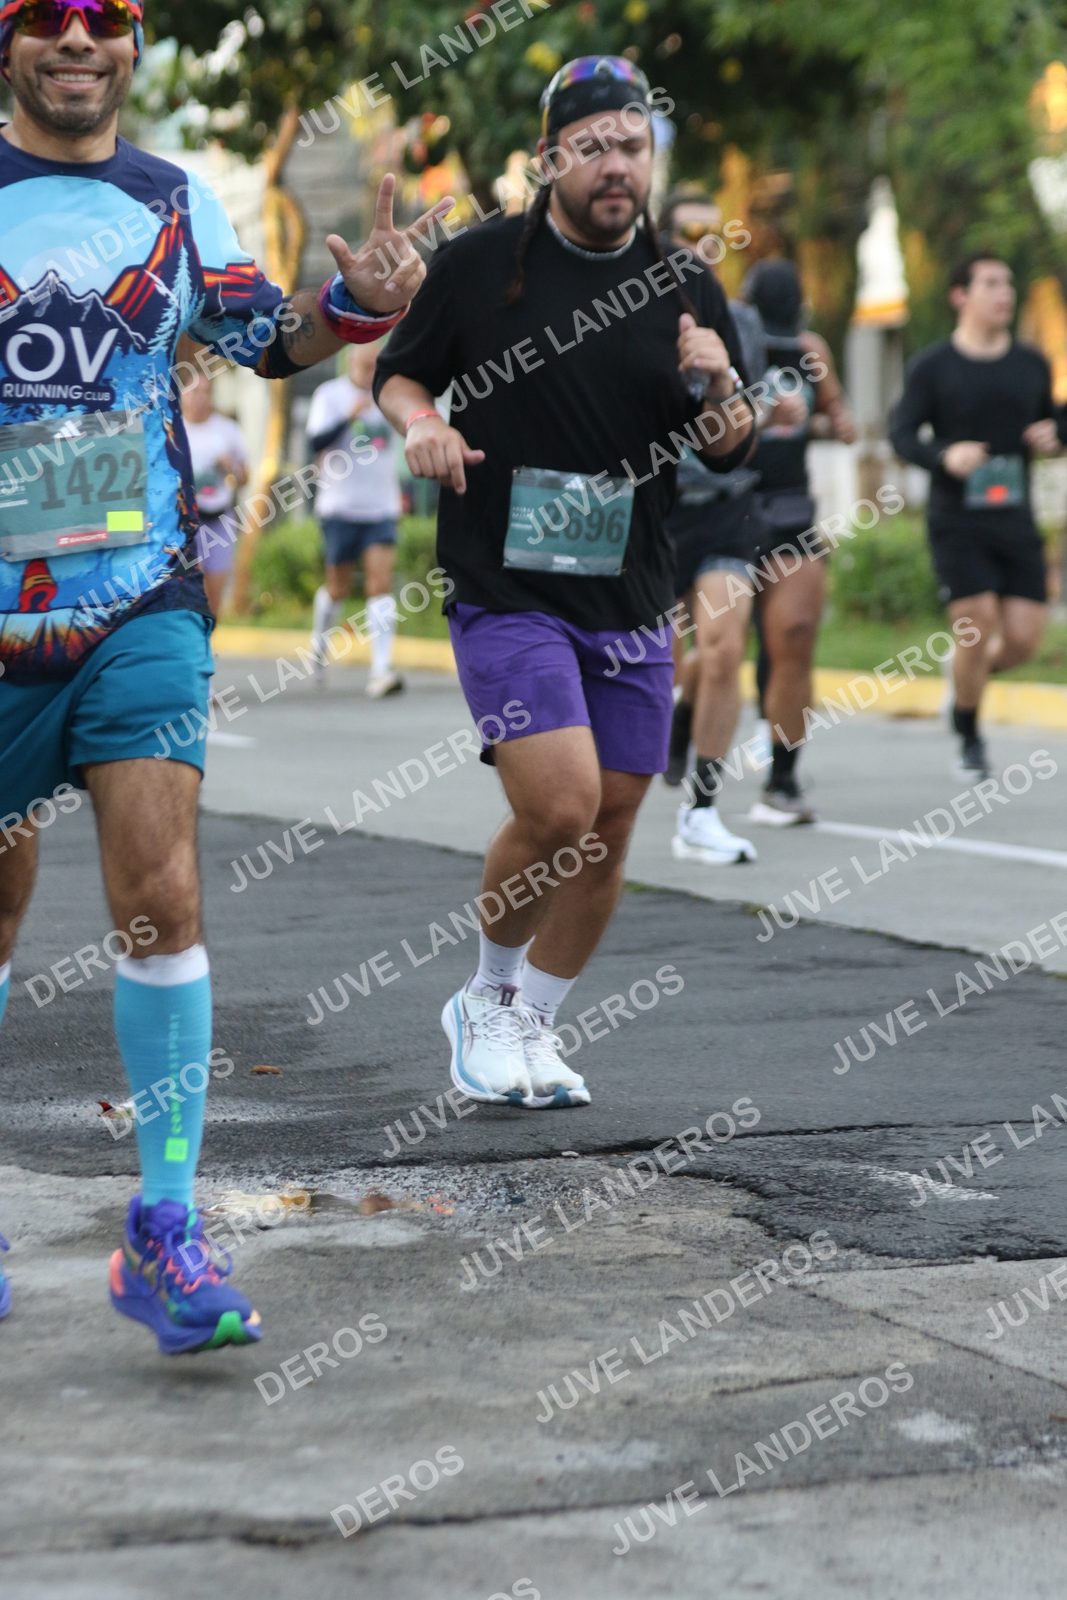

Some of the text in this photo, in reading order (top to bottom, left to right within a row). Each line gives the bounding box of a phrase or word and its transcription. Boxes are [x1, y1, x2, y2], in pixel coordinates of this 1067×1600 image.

[6, 323, 119, 383] OV
[2, 383, 111, 401] RUNNING CLUB
[41, 449, 145, 511] 1422
